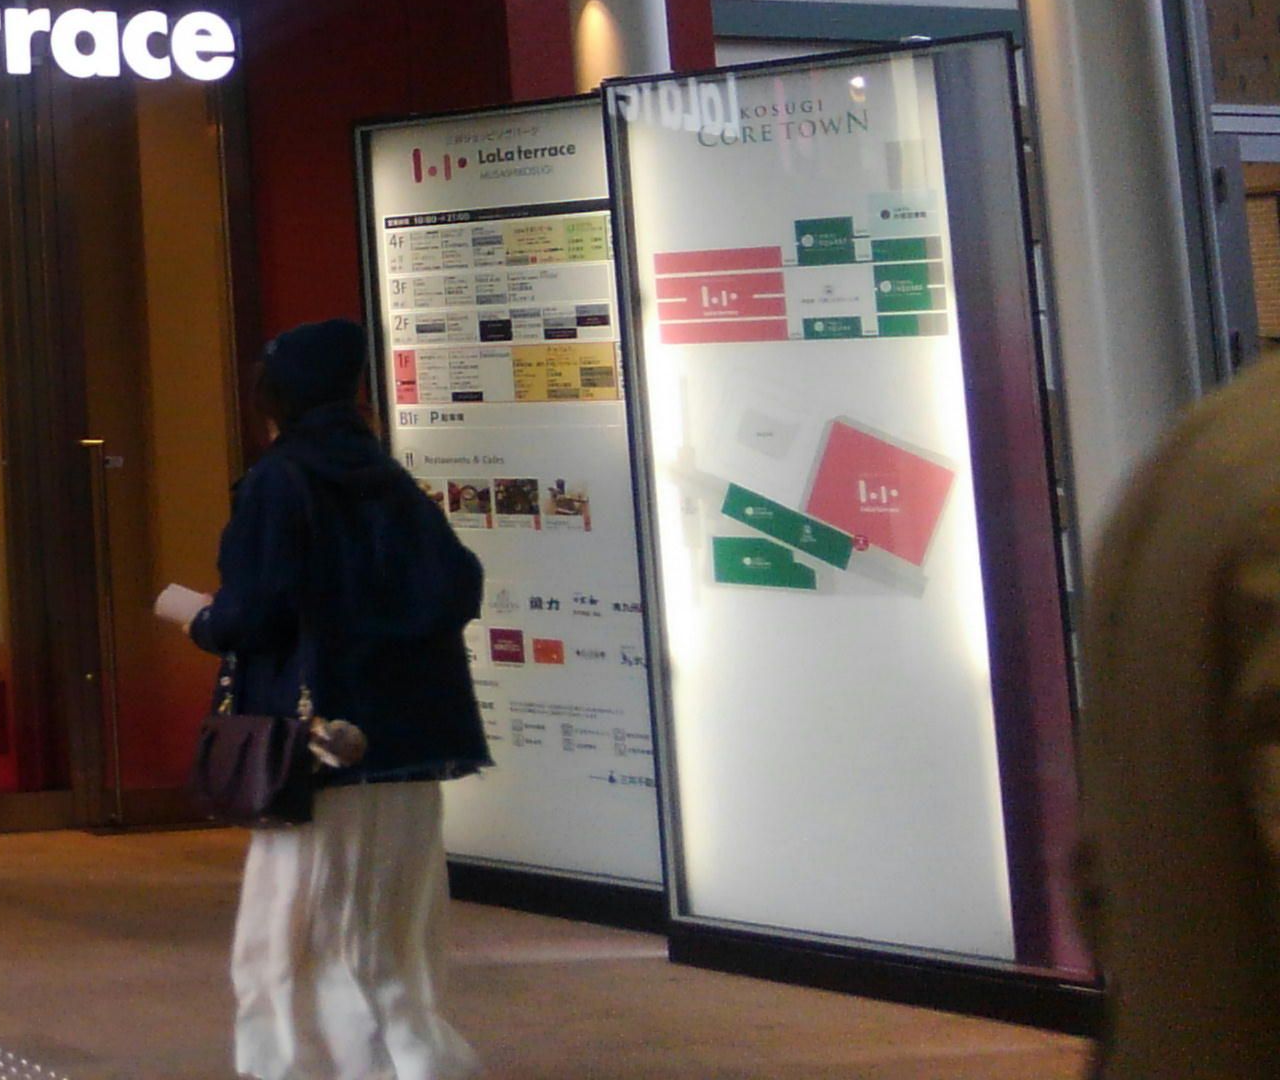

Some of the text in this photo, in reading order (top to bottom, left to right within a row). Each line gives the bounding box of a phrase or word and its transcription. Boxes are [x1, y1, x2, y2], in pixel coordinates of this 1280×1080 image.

[739, 98, 824, 120] KOSUGI
[780, 108, 870, 141] TOWN
[478, 142, 576, 164] LaLa terrace
[389, 234, 405, 250] 4F
[392, 279, 408, 296] 3F
[395, 315, 410, 331] 2F
[397, 352, 411, 368] 1F
[399, 411, 419, 426] B1F
